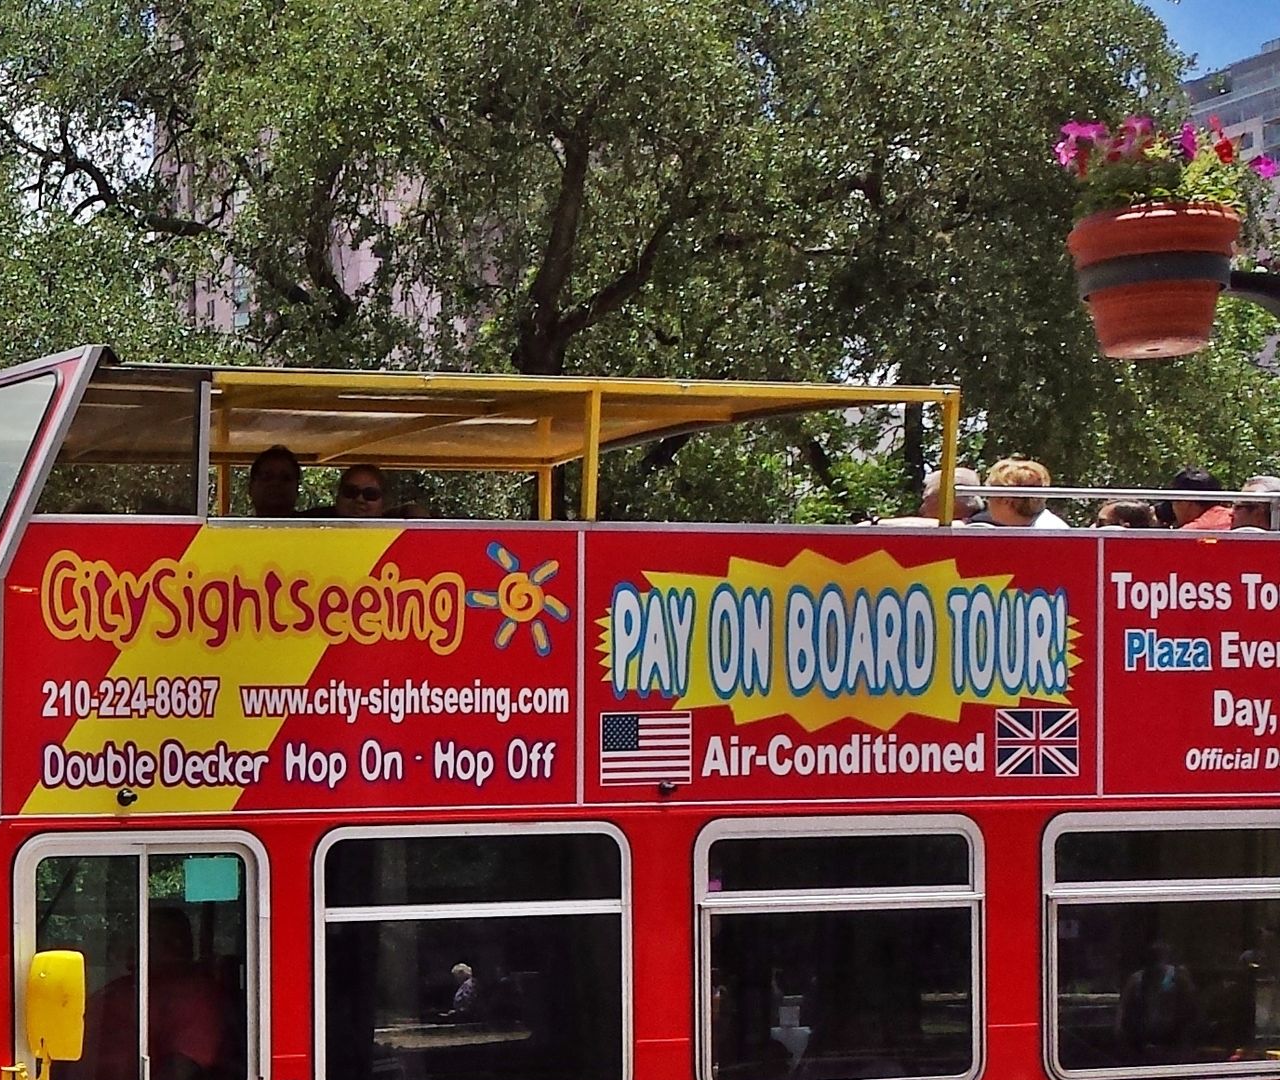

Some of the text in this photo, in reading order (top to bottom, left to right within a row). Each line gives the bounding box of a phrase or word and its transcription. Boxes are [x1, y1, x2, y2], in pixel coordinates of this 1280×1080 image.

[42, 550, 465, 656] CitySightseeing
[1110, 571, 1280, 619] Topless To
[610, 581, 1069, 699] PAY ON BOARD TOUR!
[1124, 628, 1213, 671] Plaza
[41, 678, 570, 723] 210-224-8687 www.city-sightseeing.com
[1213, 690, 1278, 736] Day,
[43, 741, 155, 788] Double
[162, 741, 269, 786] Decker
[284, 741, 347, 789] Hop
[359, 740, 403, 781] On
[432, 740, 495, 787] Hop
[506, 739, 556, 780] Off
[701, 733, 986, 779] Air-Conditioned
[1185, 748, 1261, 771] Official
